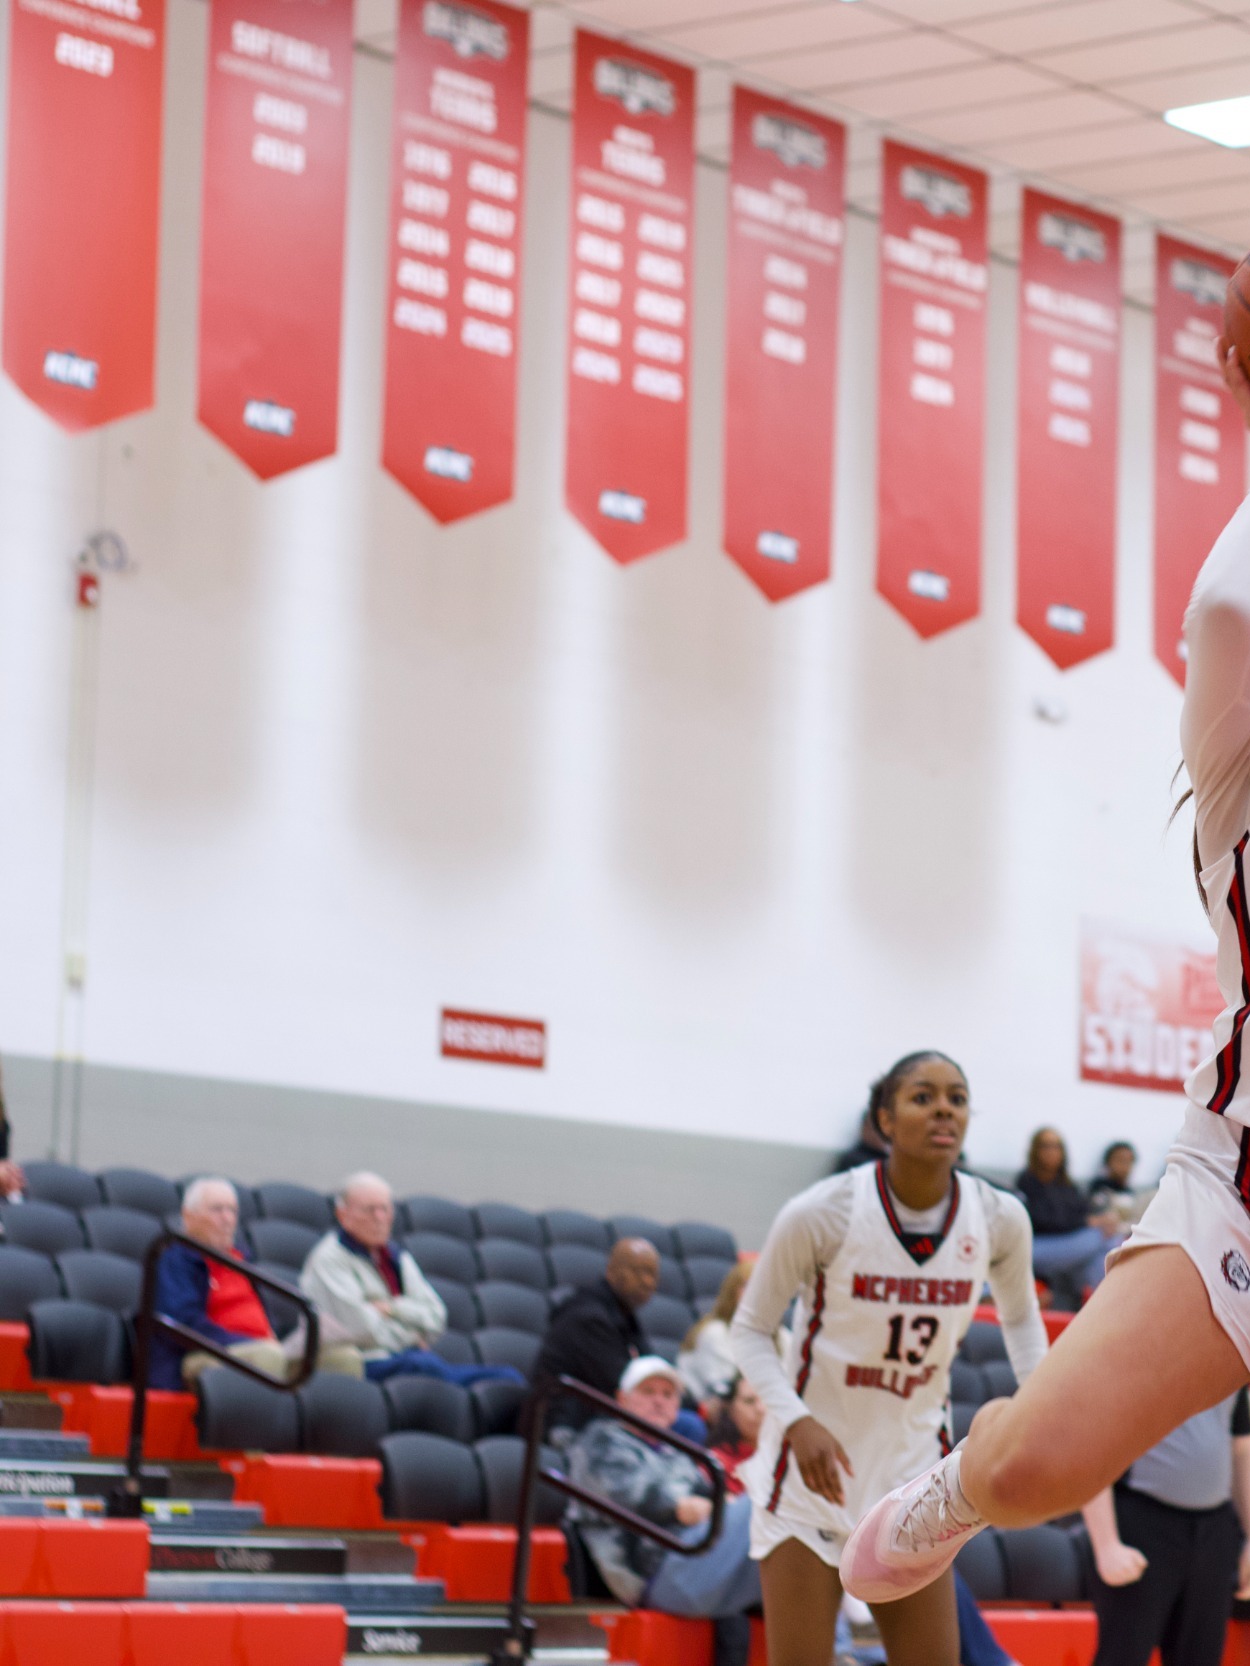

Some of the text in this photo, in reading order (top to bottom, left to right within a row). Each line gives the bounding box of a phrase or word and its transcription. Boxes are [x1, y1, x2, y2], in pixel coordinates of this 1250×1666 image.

[444, 1018, 545, 1058] RESERVED
[884, 1314, 939, 1365] 13
[362, 1628, 421, 1653] Service
